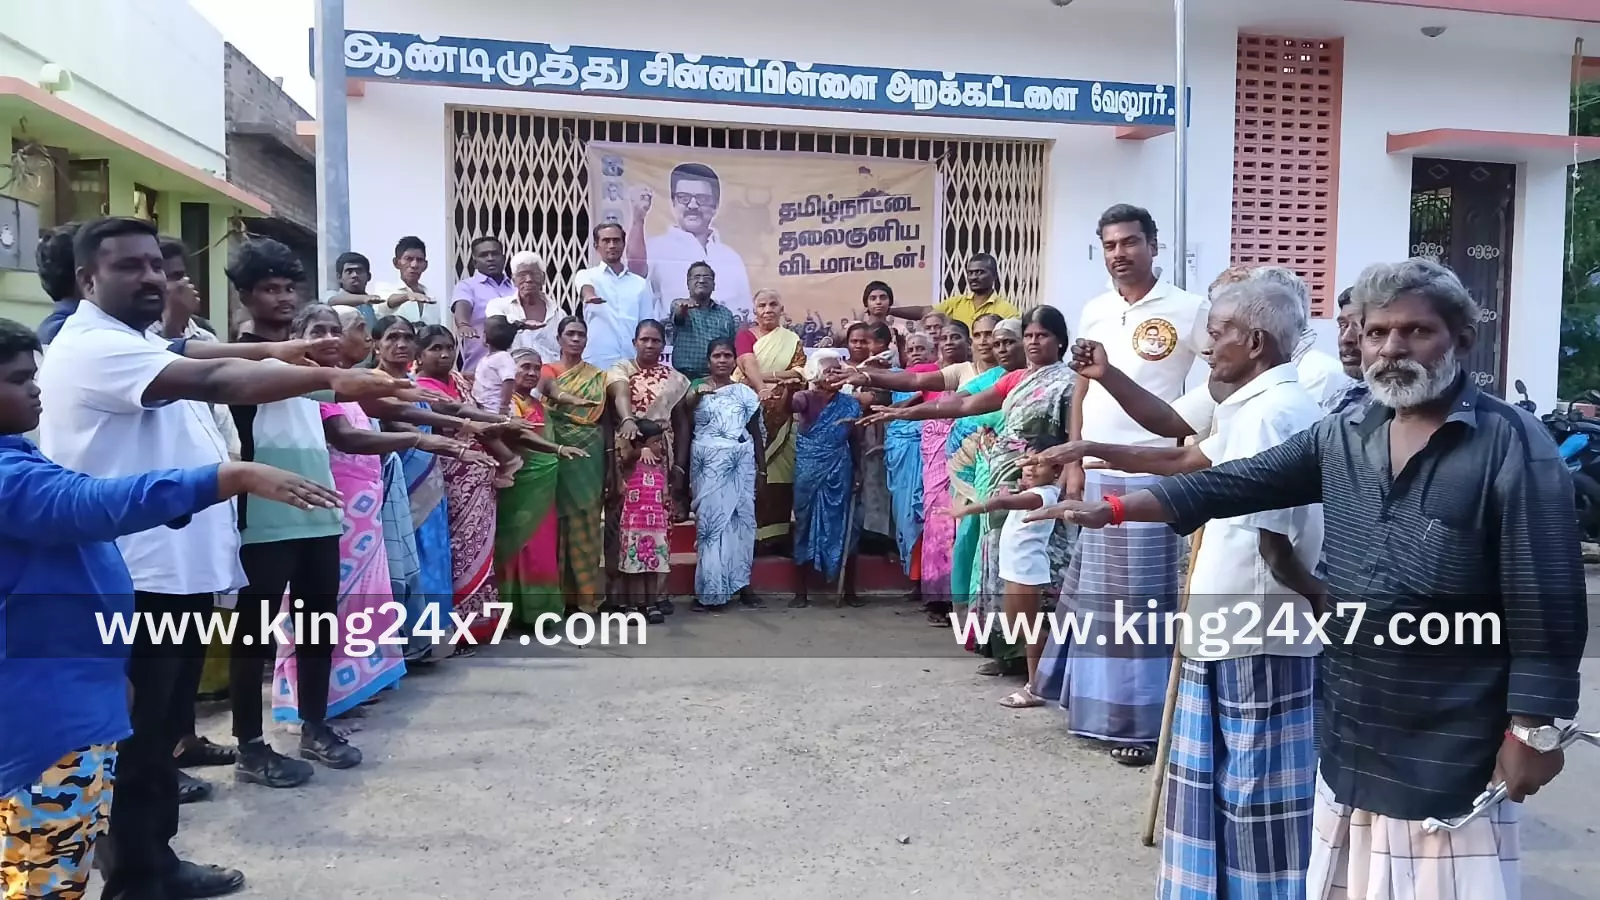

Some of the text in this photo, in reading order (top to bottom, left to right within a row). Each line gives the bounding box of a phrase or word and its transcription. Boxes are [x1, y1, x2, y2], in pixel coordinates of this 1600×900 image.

[344, 32, 629, 91] ஆண்டிமுத்து
[639, 51, 877, 100] சின்னப்பிள்ளை
[886, 71, 1078, 111] அறக்கட்டளை
[779, 193, 921, 225] தமிழ்நாட்டை
[778, 219, 919, 255] தலைகுனிய
[778, 245, 925, 276] விடமாட்டேன்!
